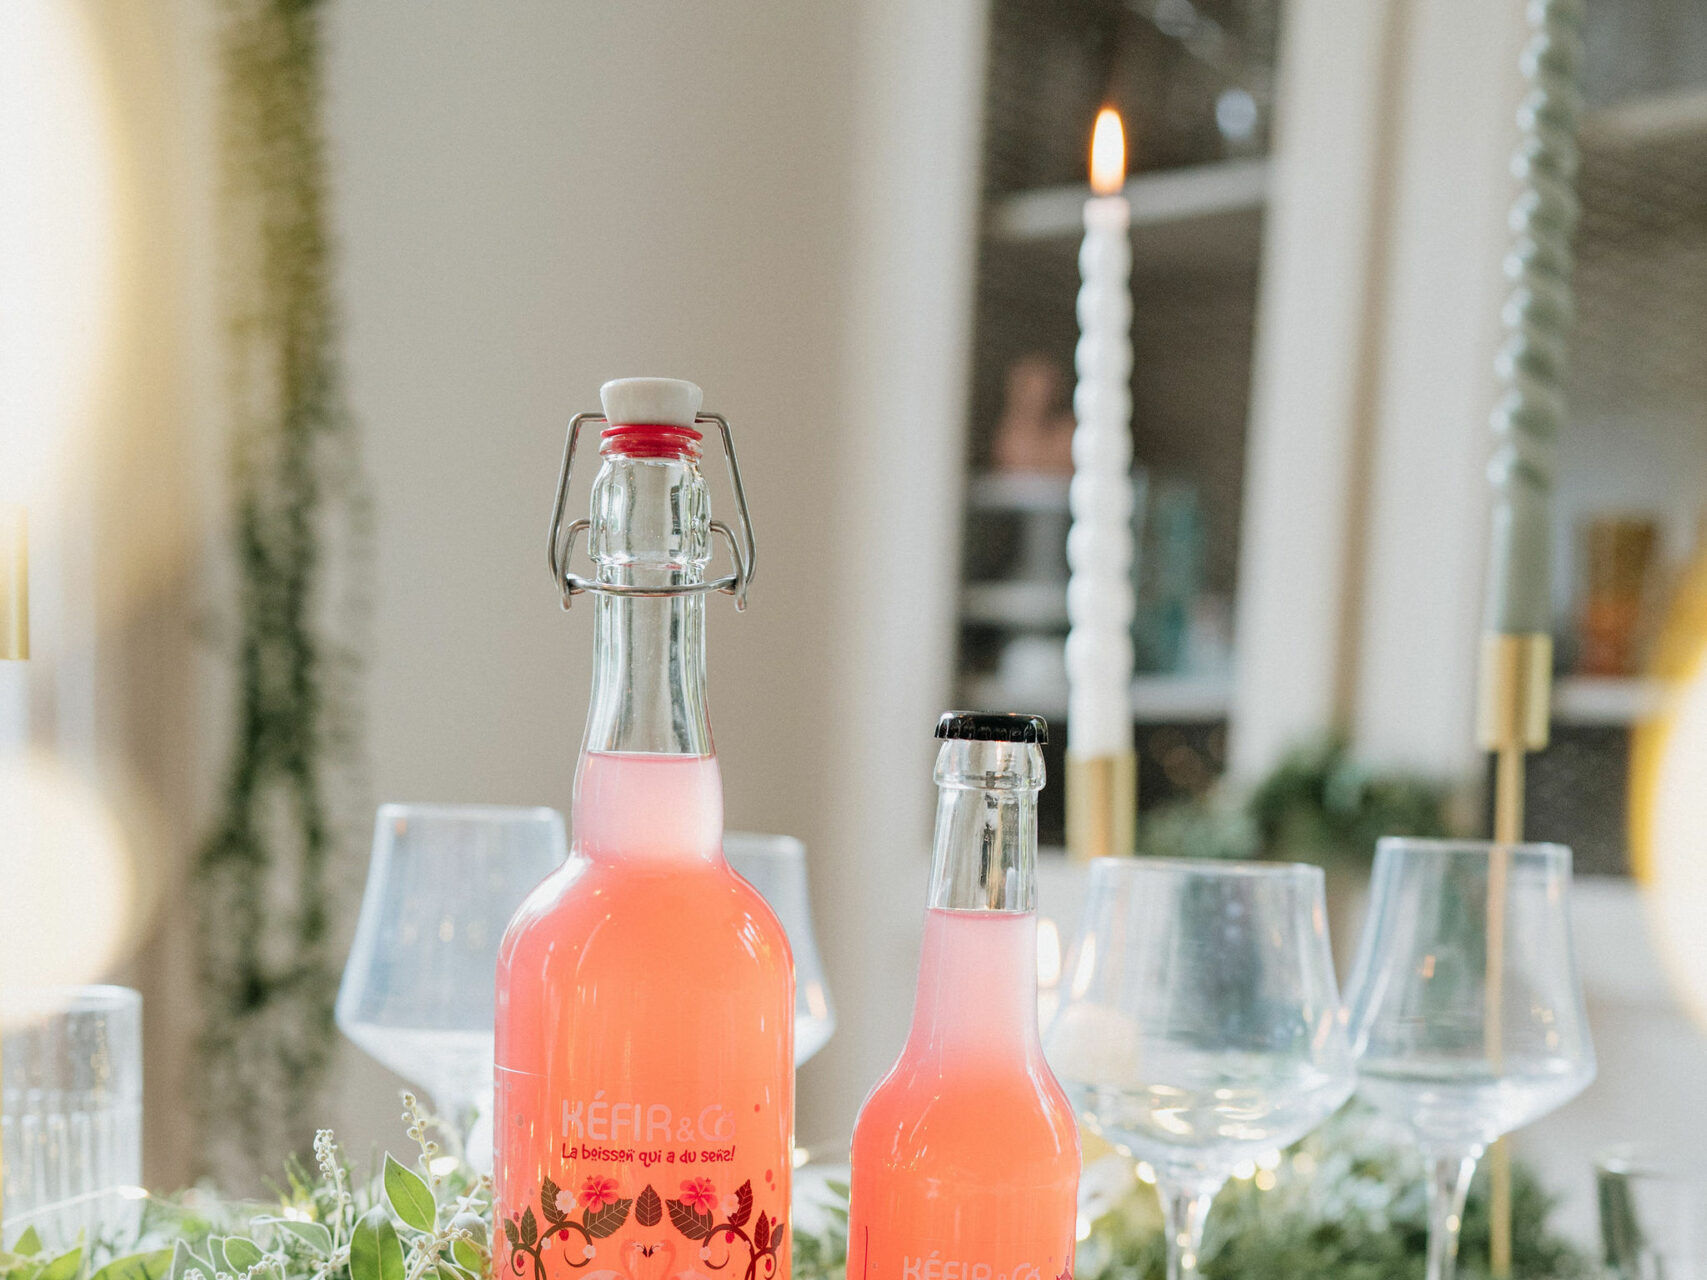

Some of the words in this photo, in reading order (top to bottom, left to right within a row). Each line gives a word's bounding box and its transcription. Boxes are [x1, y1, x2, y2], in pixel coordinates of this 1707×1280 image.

[562, 1143, 578, 1160] La
[582, 1144, 635, 1163] boisson
[639, 1149, 662, 1168] qui
[666, 1151, 675, 1164] a
[679, 1151, 697, 1164] du
